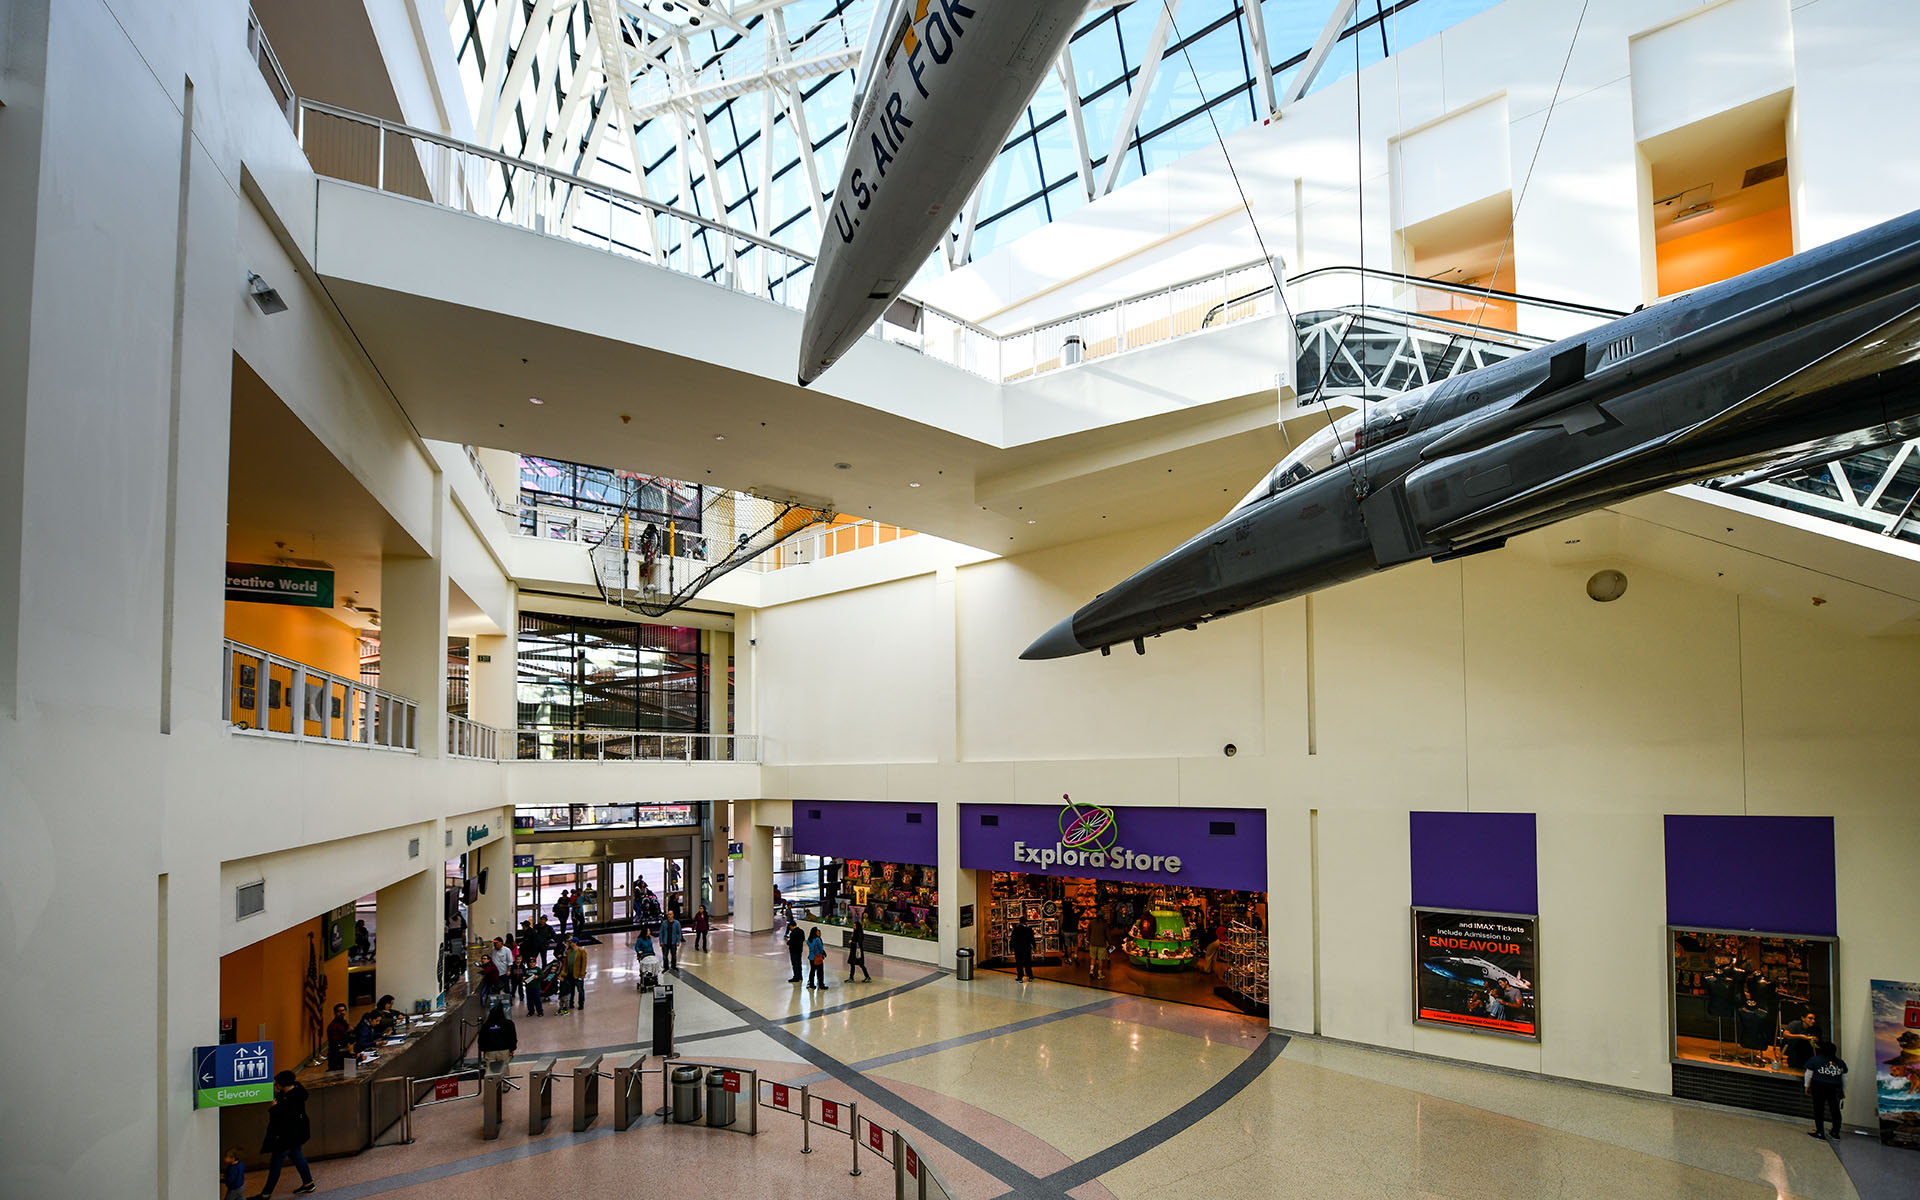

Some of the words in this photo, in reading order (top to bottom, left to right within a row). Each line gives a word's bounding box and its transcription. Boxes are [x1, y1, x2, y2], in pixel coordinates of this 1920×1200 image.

[835, 168, 878, 244] U.S.
[871, 92, 914, 178] AIR
[226, 577, 275, 588] reative
[280, 579, 318, 592] World
[1013, 841, 1105, 870] Explora
[1110, 846, 1182, 873] Store
[1437, 929, 1463, 937] Include
[1464, 931, 1501, 940] Admission
[1497, 924, 1525, 933] Tickets
[1429, 936, 1520, 955] ENDEAVOUR
[217, 1089, 260, 1101] Elevator
